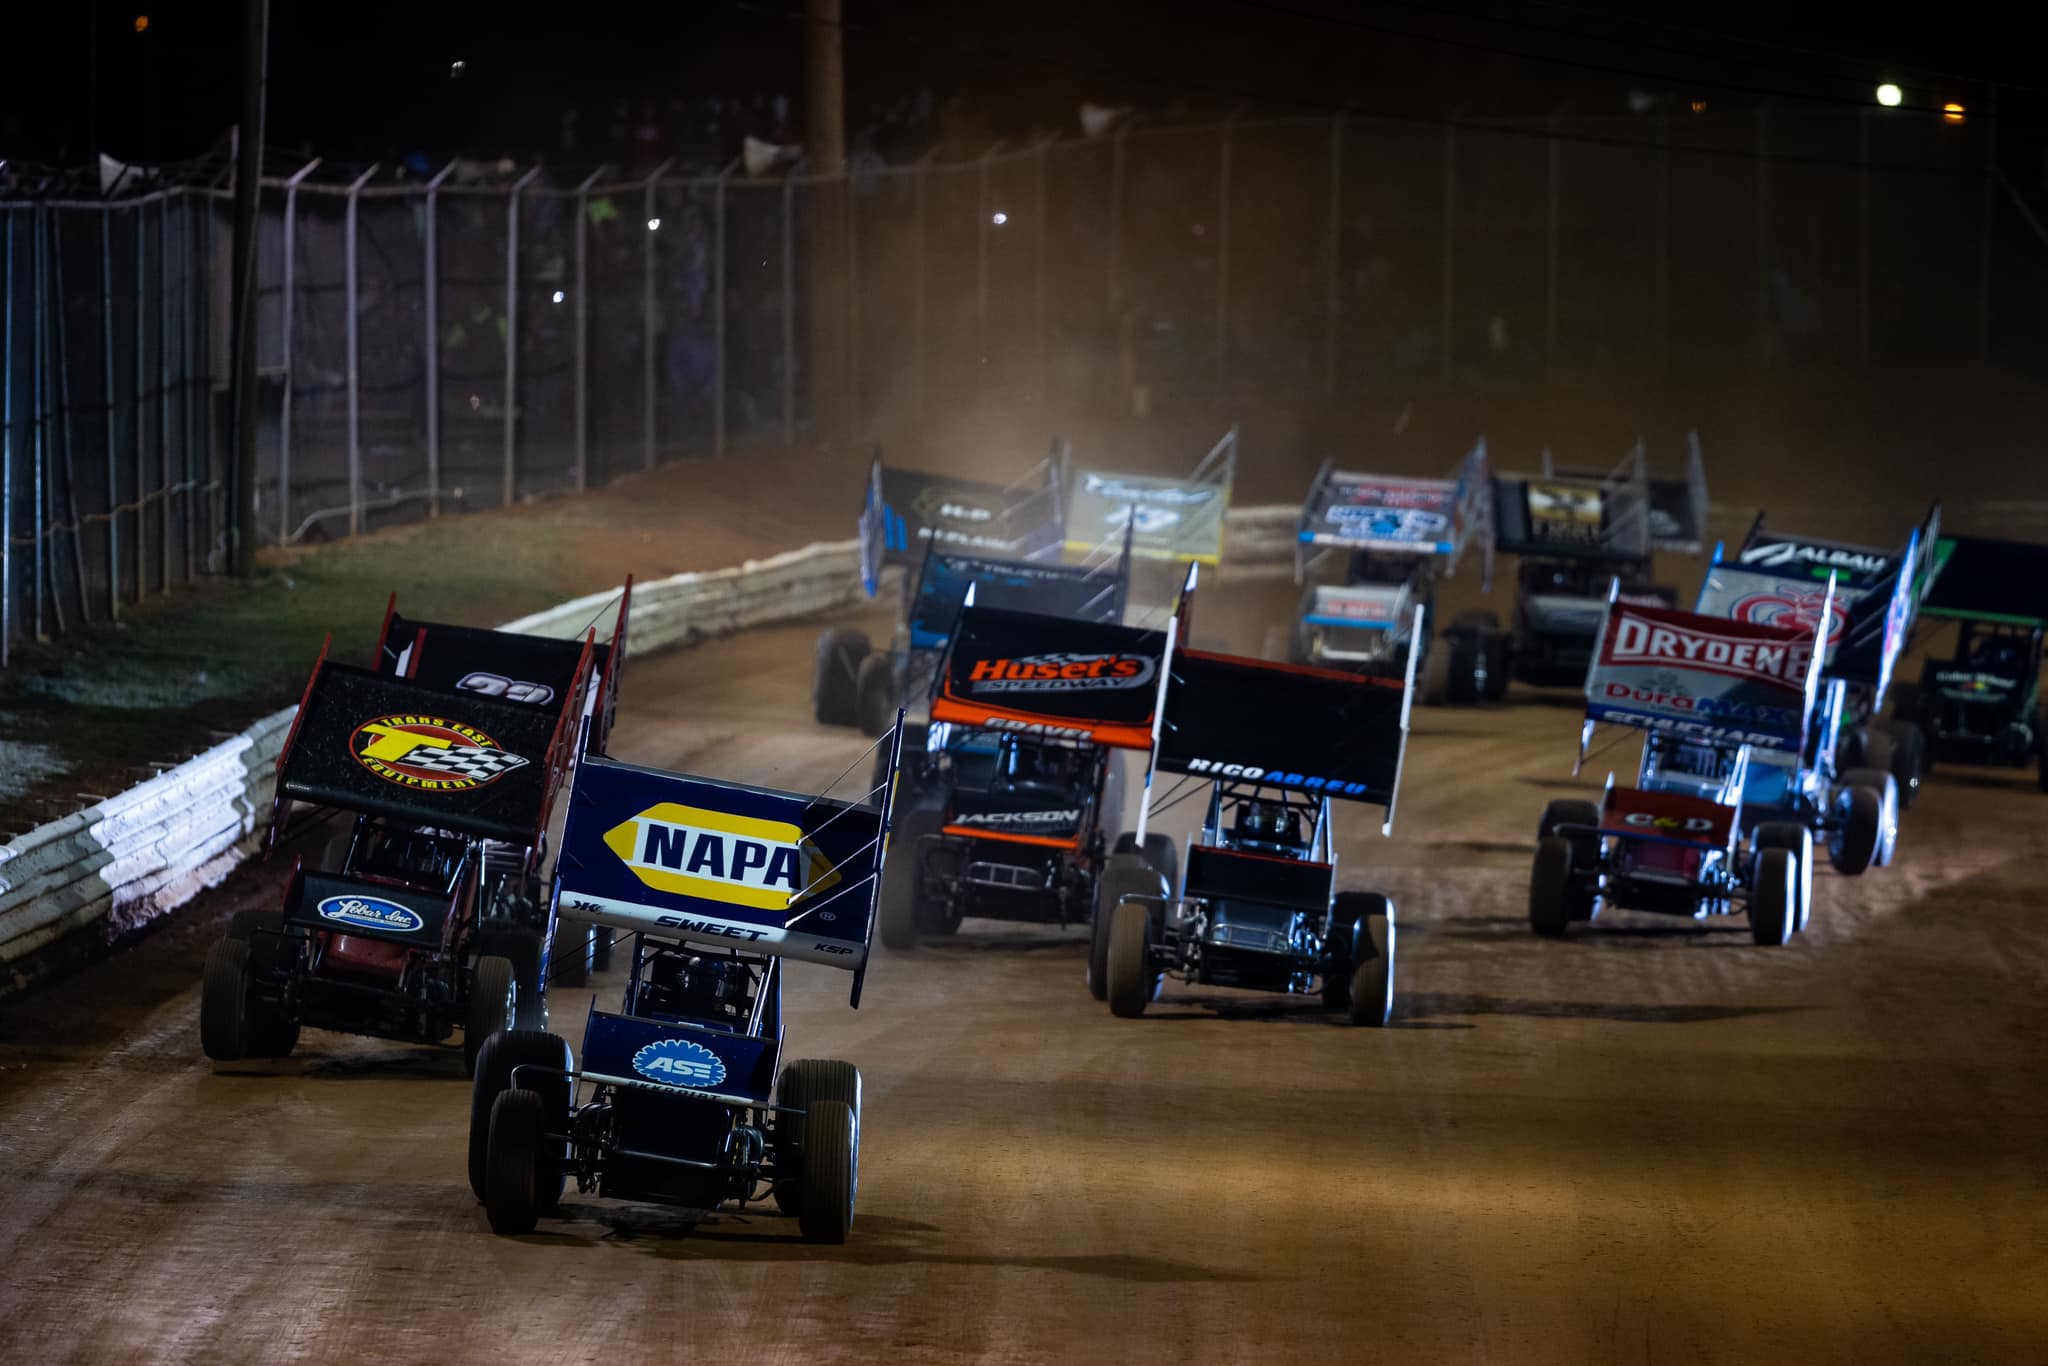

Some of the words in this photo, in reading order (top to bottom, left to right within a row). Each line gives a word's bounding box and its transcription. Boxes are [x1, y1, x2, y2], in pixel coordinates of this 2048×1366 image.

[968, 655, 1140, 682] Huset's
[990, 676, 1128, 690] SPEEDWAY
[379, 715, 446, 728] TRANS
[452, 723, 494, 748] EAST
[362, 756, 479, 790] EQUIPMENT
[952, 808, 1080, 825] JACKSON
[643, 823, 800, 890] NAPA
[654, 915, 768, 942] SWEET
[814, 942, 853, 955] KSP
[644, 1056, 713, 1080] ASE
